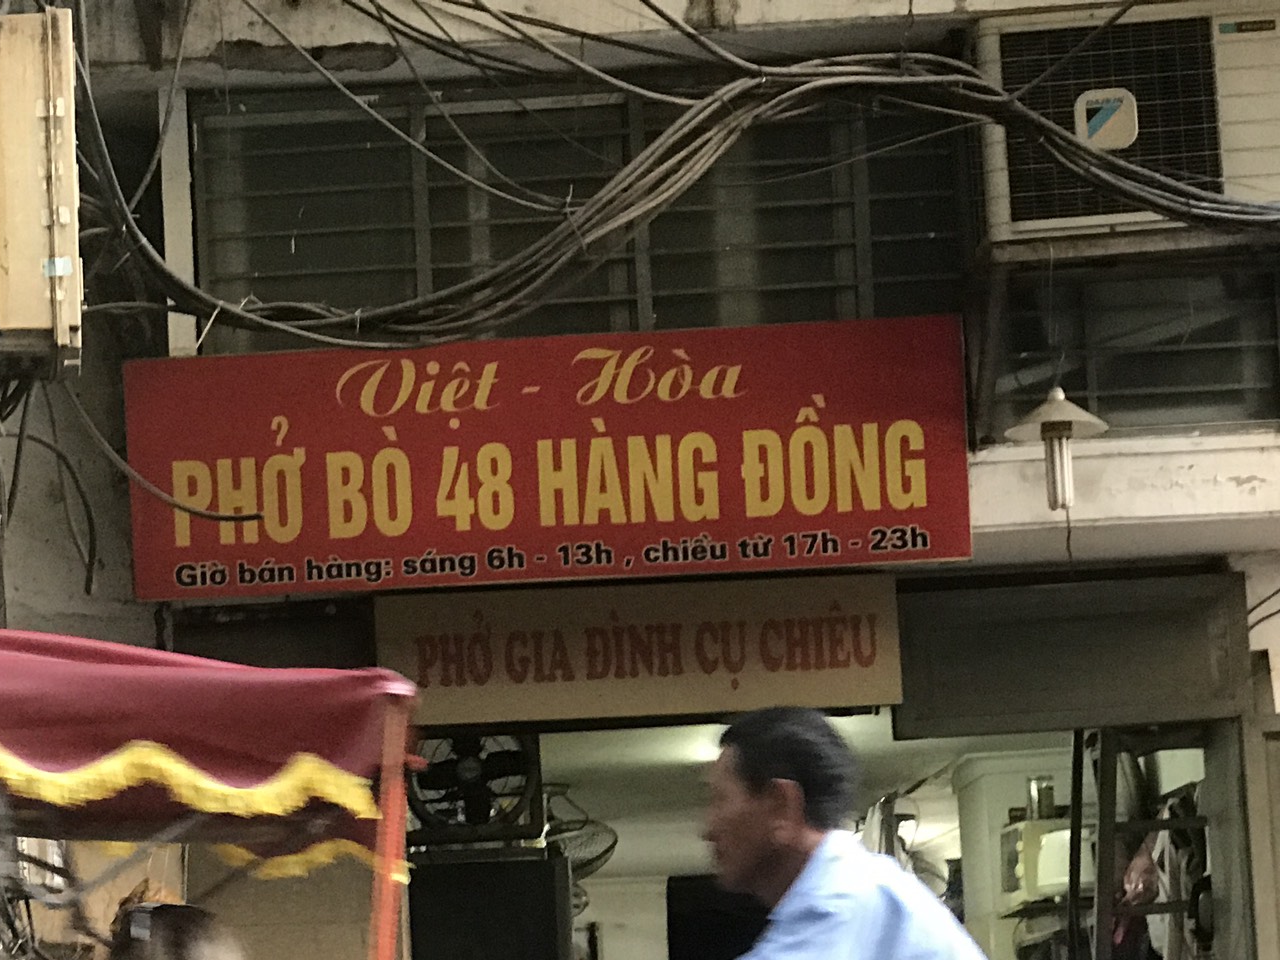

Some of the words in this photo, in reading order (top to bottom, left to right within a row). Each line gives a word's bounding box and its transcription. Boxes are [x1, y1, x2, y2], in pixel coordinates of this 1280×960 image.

[335, 358, 501, 430] Việt
[572, 345, 749, 404] Hòa
[172, 415, 306, 547] PHỞ
[325, 425, 413, 539] BÒ
[436, 442, 515, 531] 48
[537, 417, 720, 526] HÀNG
[741, 394, 928, 518] ĐỒNG
[175, 562, 228, 587] Giờ
[238, 559, 296, 584] bán
[306, 552, 393, 583] hàng:
[402, 547, 477, 577] sáng
[486, 545, 525, 570] 6h
[556, 542, 613, 567] 13h
[643, 534, 728, 564] chiều
[738, 535, 773, 559] từ
[782, 531, 839, 556] 17h
[870, 525, 929, 552] 23h
[414, 609, 493, 689] PHỞ
[505, 628, 575, 685] GIA
[584, 610, 683, 681] ĐÌNH
[695, 620, 747, 691] CỤ
